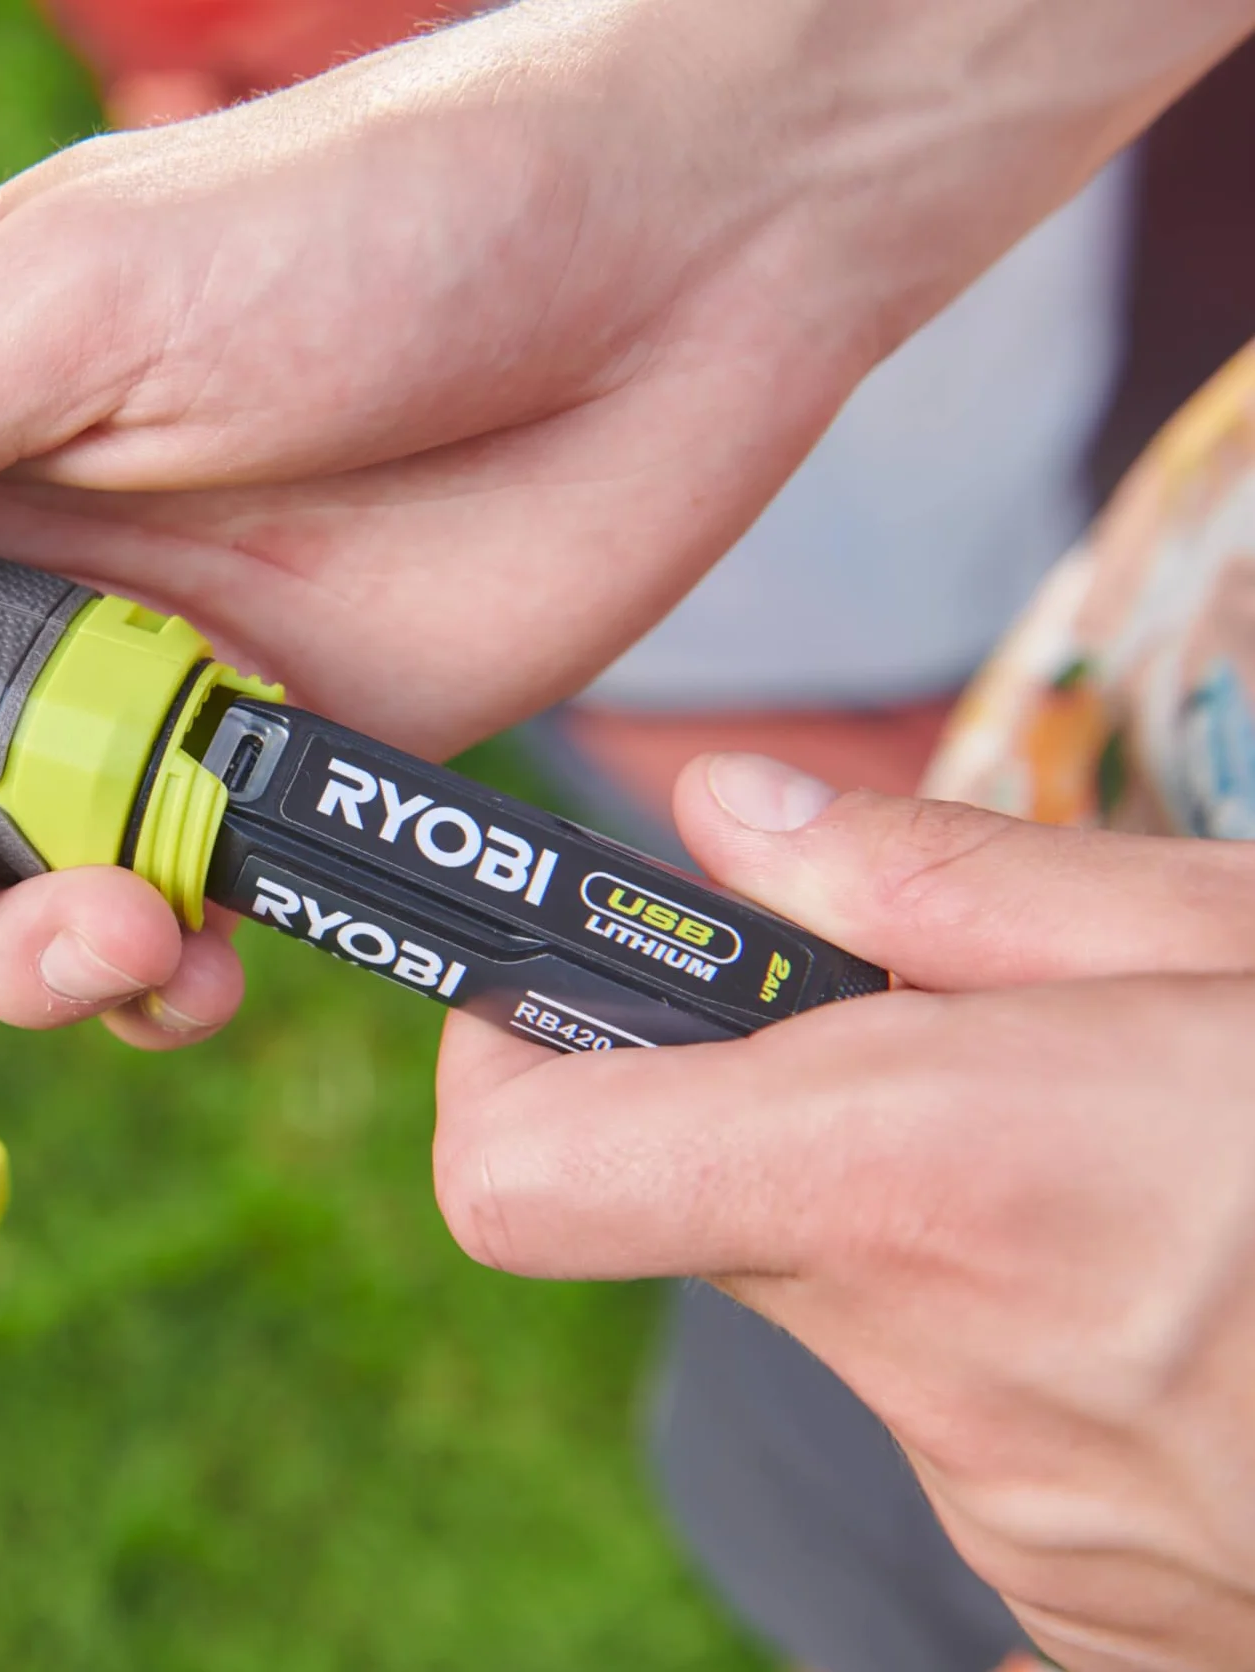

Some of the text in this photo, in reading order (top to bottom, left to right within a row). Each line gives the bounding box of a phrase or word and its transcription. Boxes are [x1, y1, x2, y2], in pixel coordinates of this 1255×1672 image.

[316, 757, 559, 906] RYOBI
[251, 877, 466, 998] RYOBI
[585, 914, 718, 982] LITHIUM
[607, 888, 715, 946] USB
[759, 951, 792, 1003] 2Ah
[513, 1001, 613, 1051] RB420
